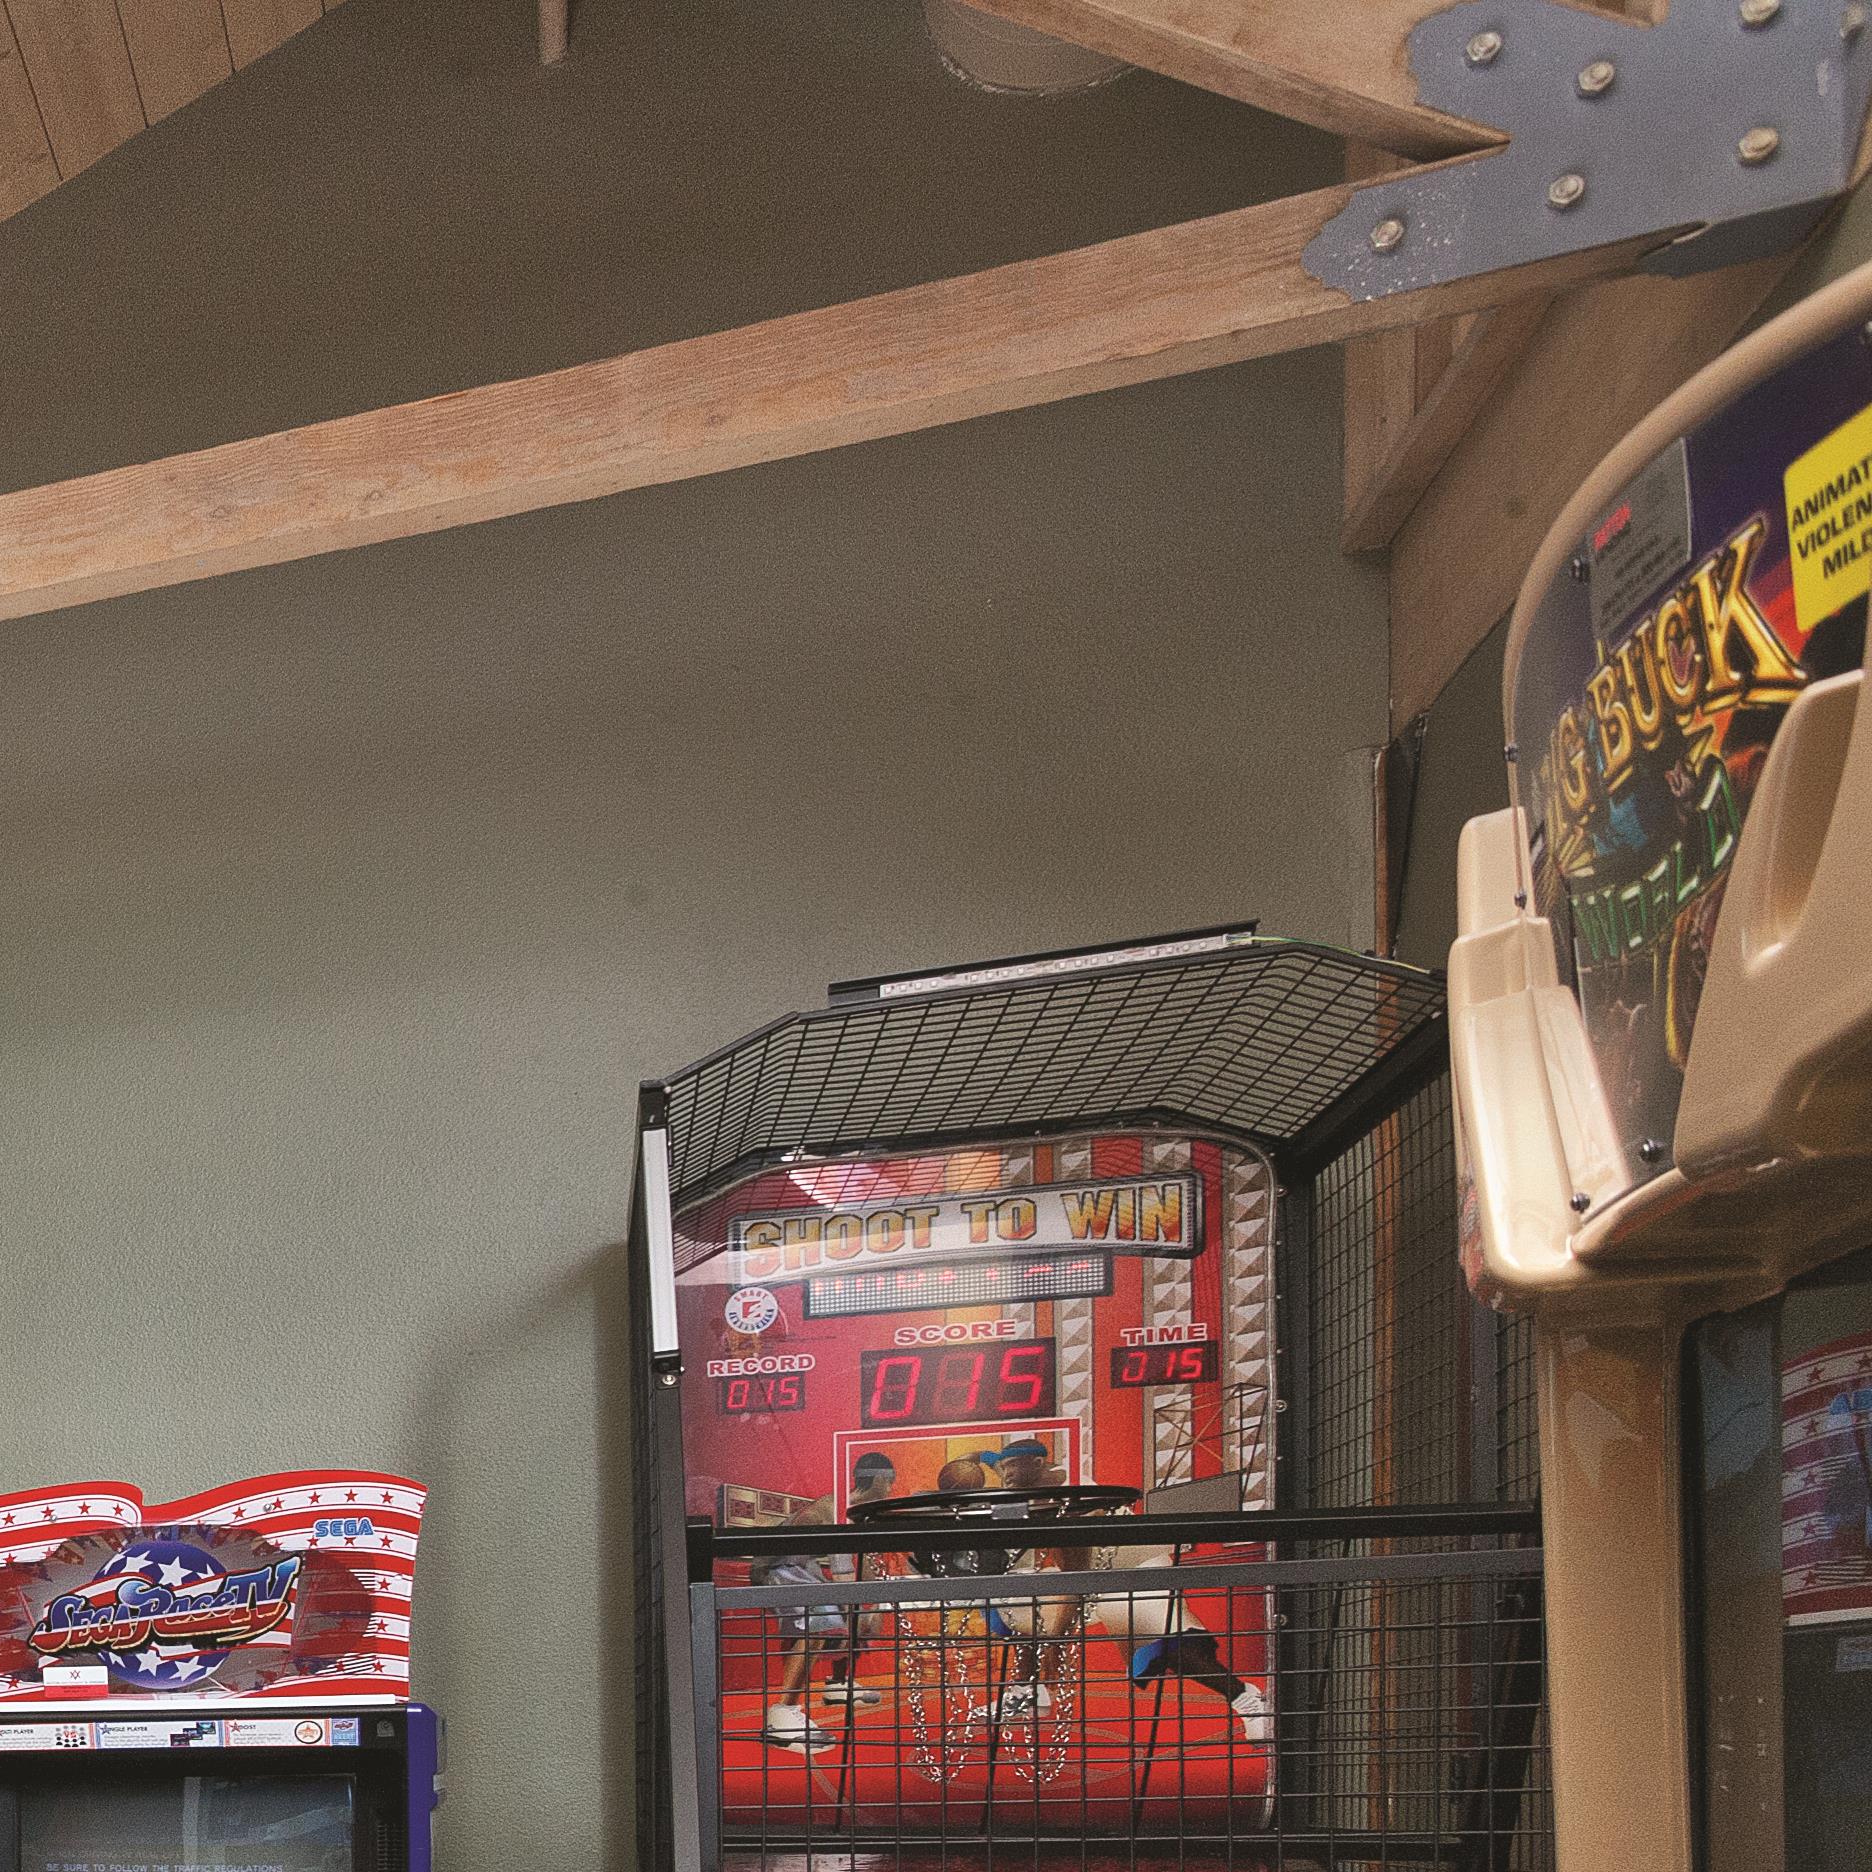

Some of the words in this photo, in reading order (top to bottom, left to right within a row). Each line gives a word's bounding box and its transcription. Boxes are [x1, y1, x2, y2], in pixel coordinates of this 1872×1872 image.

[1791, 455, 1872, 530] ANIMAT
[1797, 492, 1872, 559] VIOLEN
[1588, 511, 1809, 780] BUCK
[743, 1206, 941, 1279] SHOOT
[961, 1197, 1038, 1244] TO
[1060, 1182, 1184, 1244] WIN
[894, 1319, 1017, 1346] SCORE
[1120, 1322, 1209, 1346] TIME
[706, 1353, 816, 1377] RECORD
[314, 1517, 374, 1537] SEGA
[63, 1863, 88, 1872] SURE
[94, 1864, 106, 1872] TO
[109, 1864, 148, 1872] FOLLOW
[152, 1864, 169, 1872] THE
